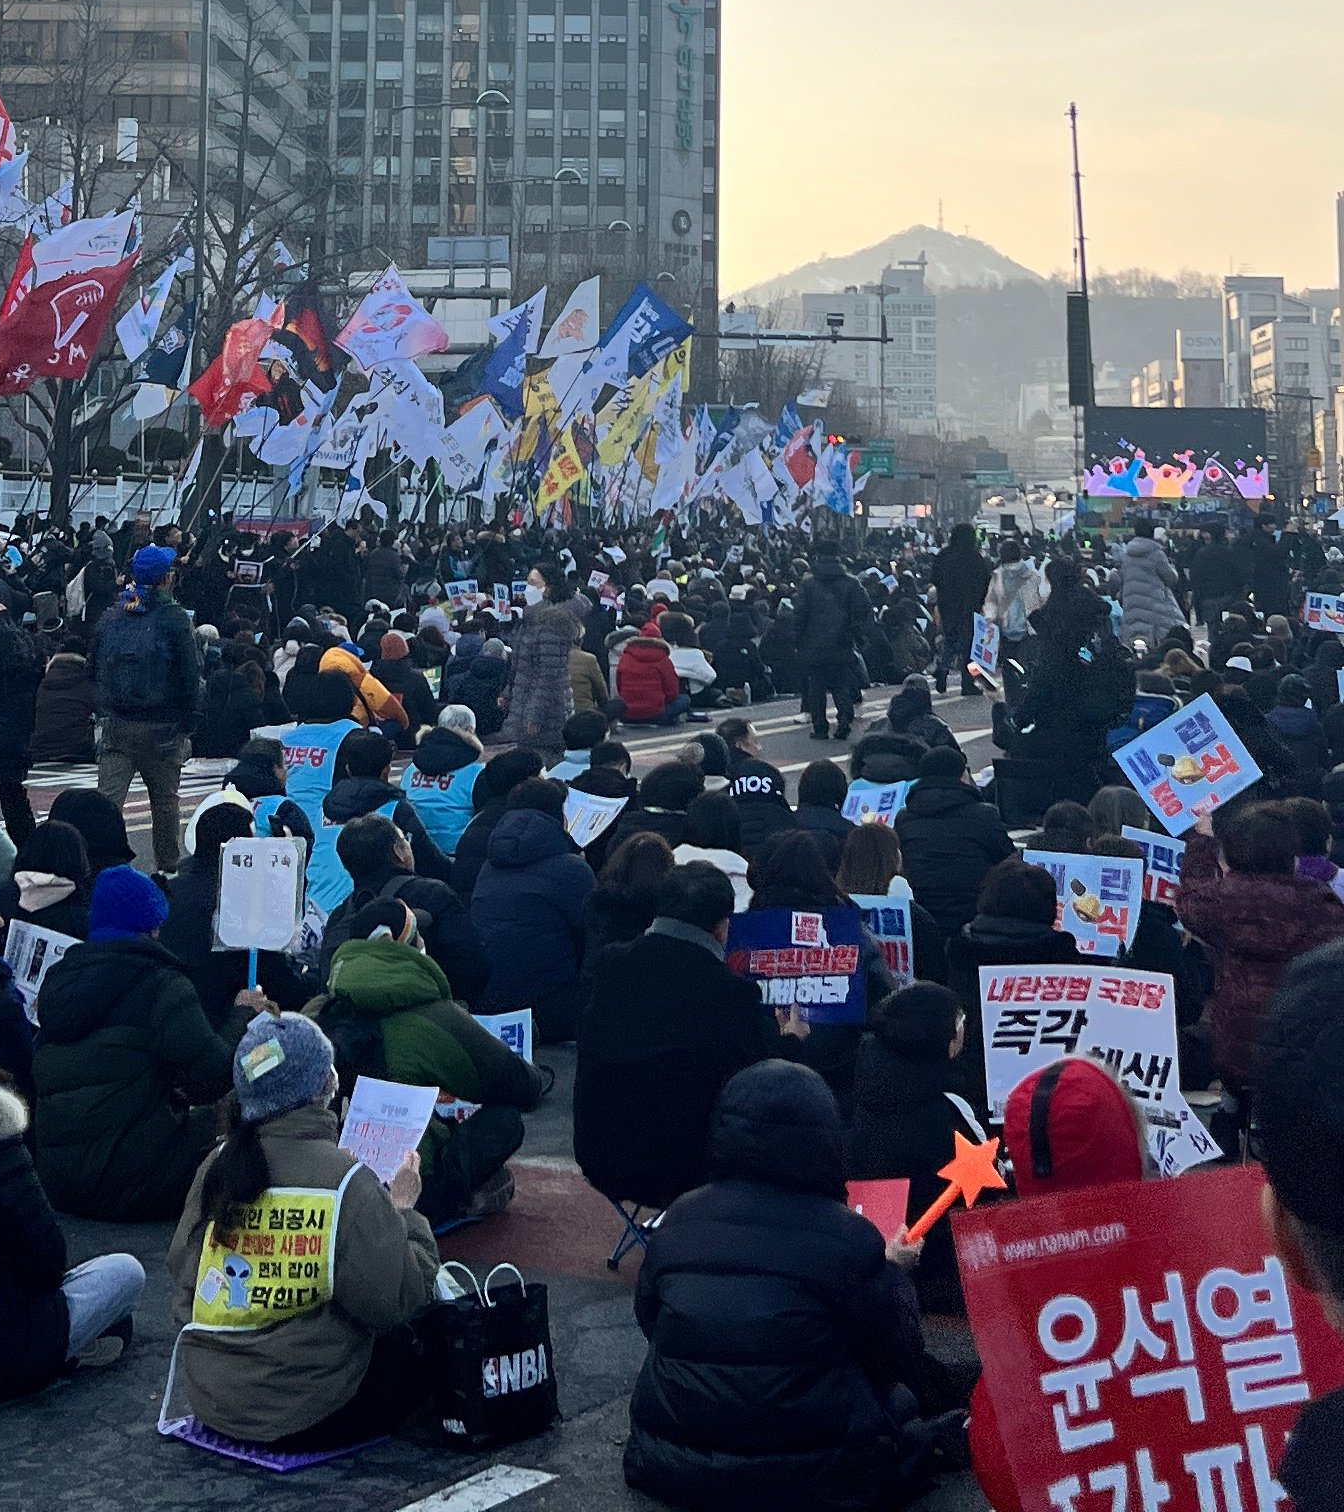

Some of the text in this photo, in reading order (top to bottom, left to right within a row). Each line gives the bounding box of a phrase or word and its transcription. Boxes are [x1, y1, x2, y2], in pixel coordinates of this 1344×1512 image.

[410, 770, 456, 792] 진보당
[750, 945, 859, 977] 국민의힘
[986, 975, 1092, 1003] 내란정범
[991, 1008, 1089, 1055] 즉각
[268, 1207, 326, 1230] 침공시
[258, 1261, 321, 1279] 먼저 잡아
[250, 1286, 321, 1310] 먹힌다
[1037, 1255, 1310, 1454] 윤석열
[499, 1343, 547, 1395] NBA
